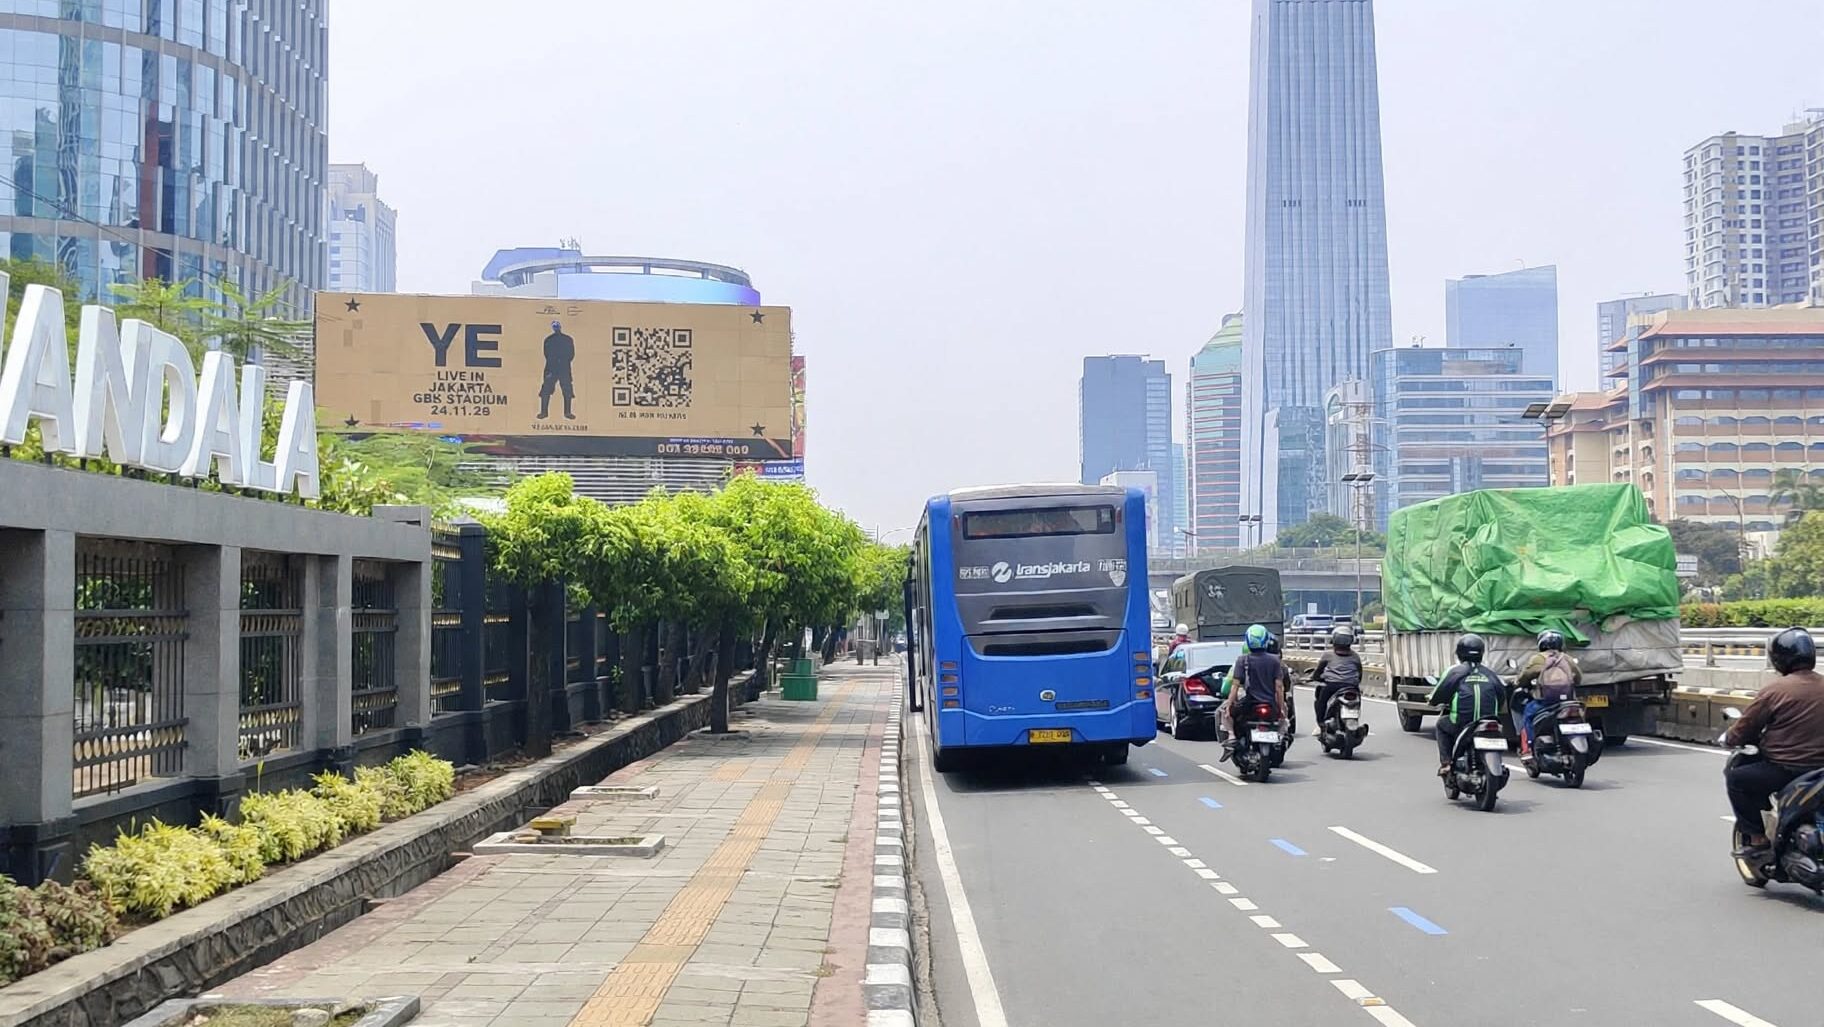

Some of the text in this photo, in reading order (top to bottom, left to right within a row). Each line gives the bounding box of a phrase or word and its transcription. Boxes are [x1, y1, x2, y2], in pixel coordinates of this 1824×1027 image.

[419, 322, 502, 367] YE
[437, 371, 484, 381] LIVE IN
[0, 270, 320, 499] ANDALA
[429, 382, 493, 393] JAKARTA
[413, 393, 507, 405] GBK STADIUM
[1015, 561, 1091, 579] transjakarta
